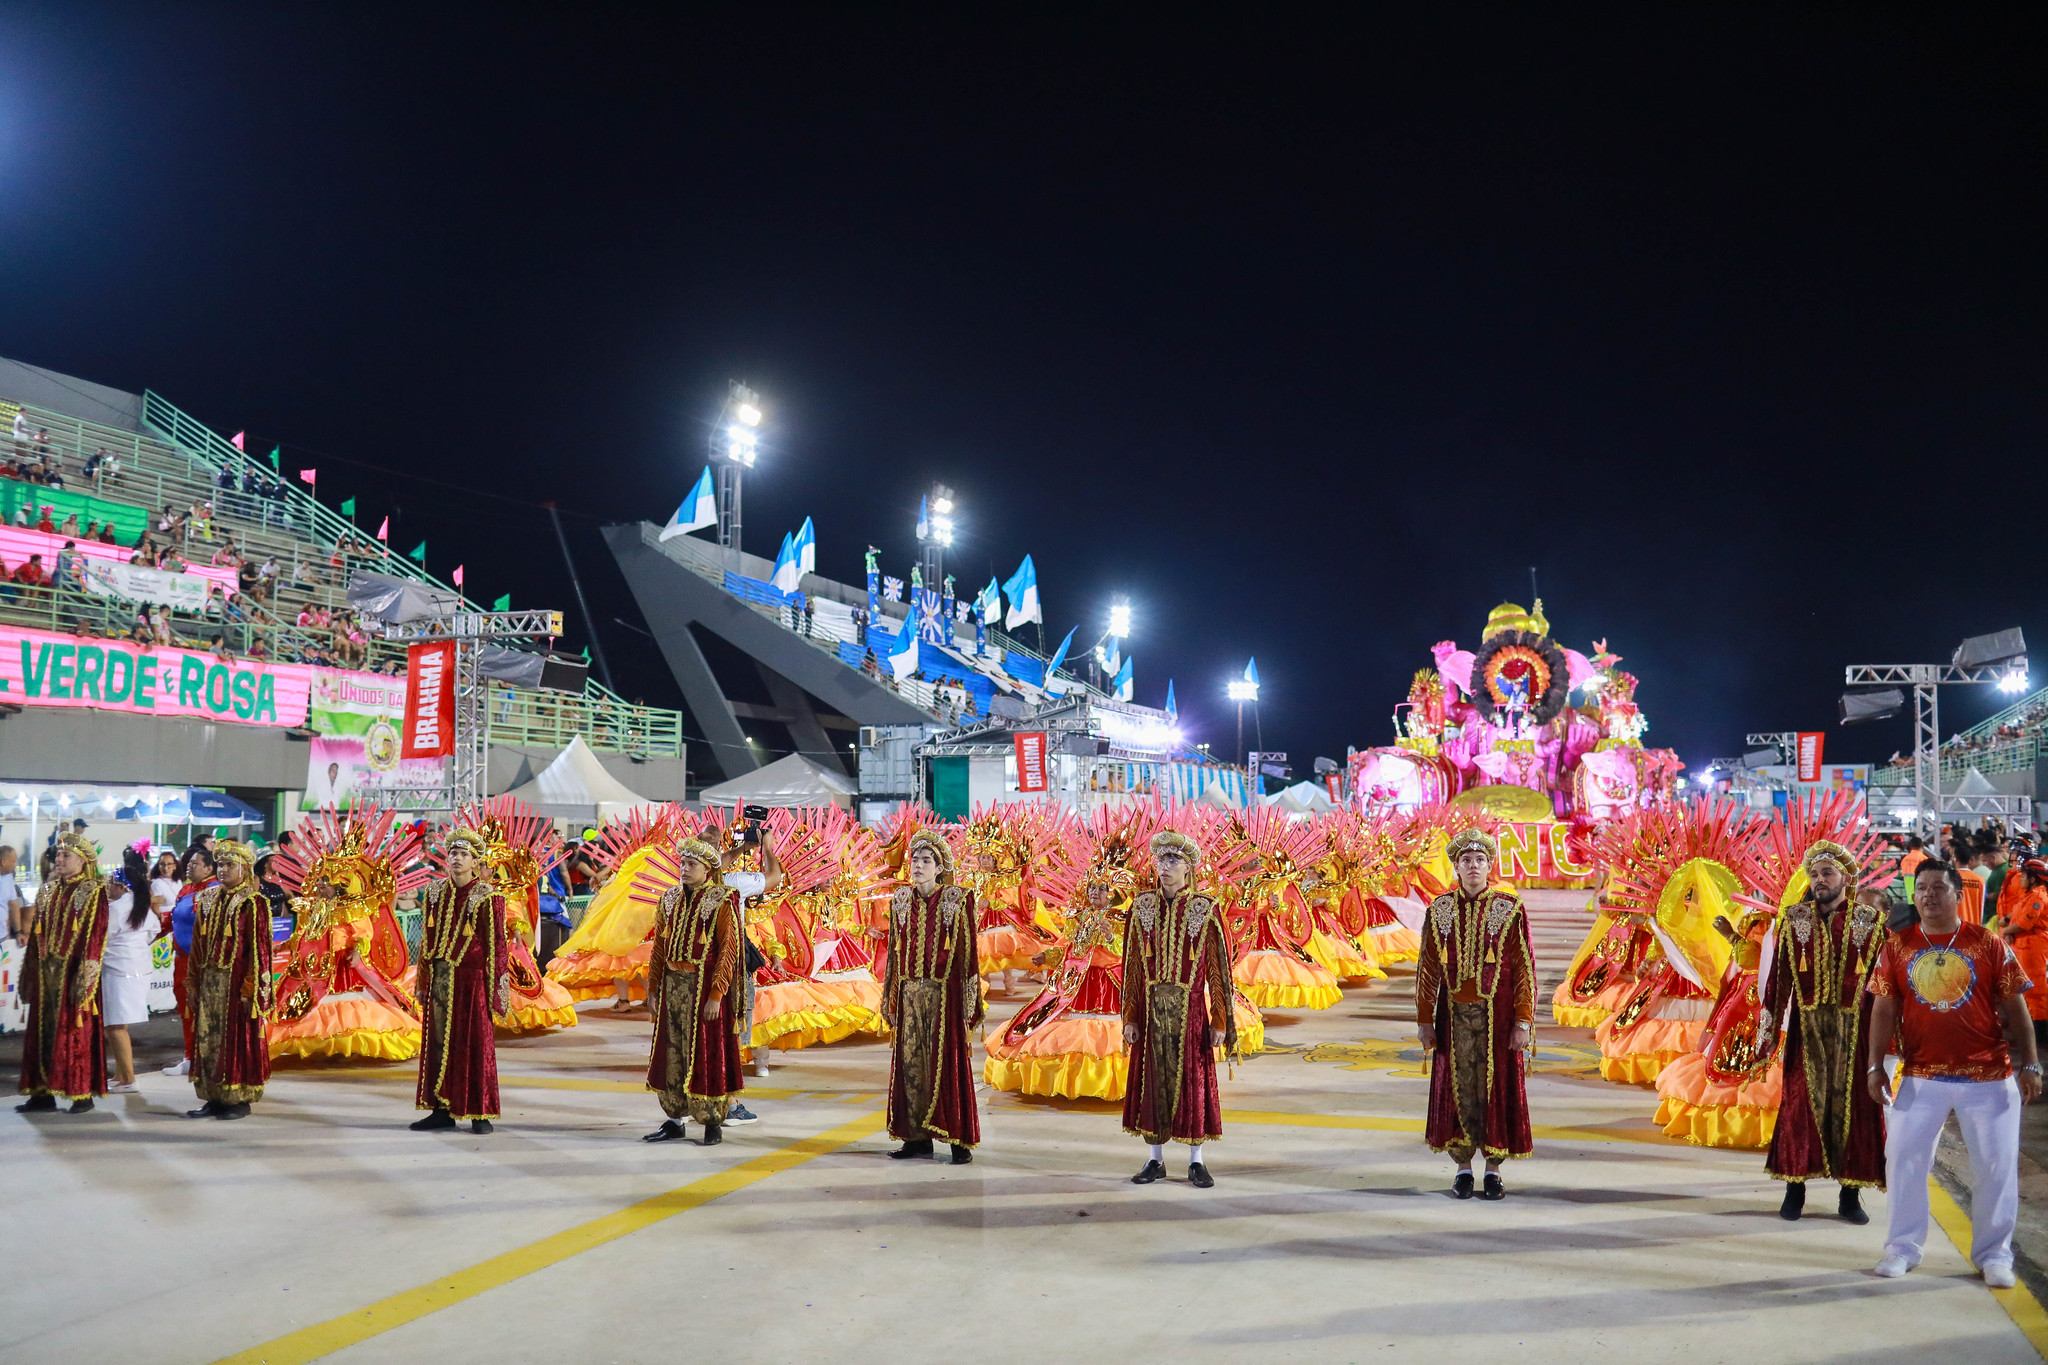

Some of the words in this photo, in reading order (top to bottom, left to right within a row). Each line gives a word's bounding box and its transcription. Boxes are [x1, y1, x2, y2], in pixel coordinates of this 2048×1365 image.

[21, 640, 158, 708] VERDE
[163, 668, 174, 694] E
[179, 655, 277, 723] ROSA
[389, 692, 403, 707] DA
[414, 651, 443, 749] BRAHMA
[1023, 737, 1042, 788] BRAHMA
[1801, 736, 1816, 779] BRAHMA
